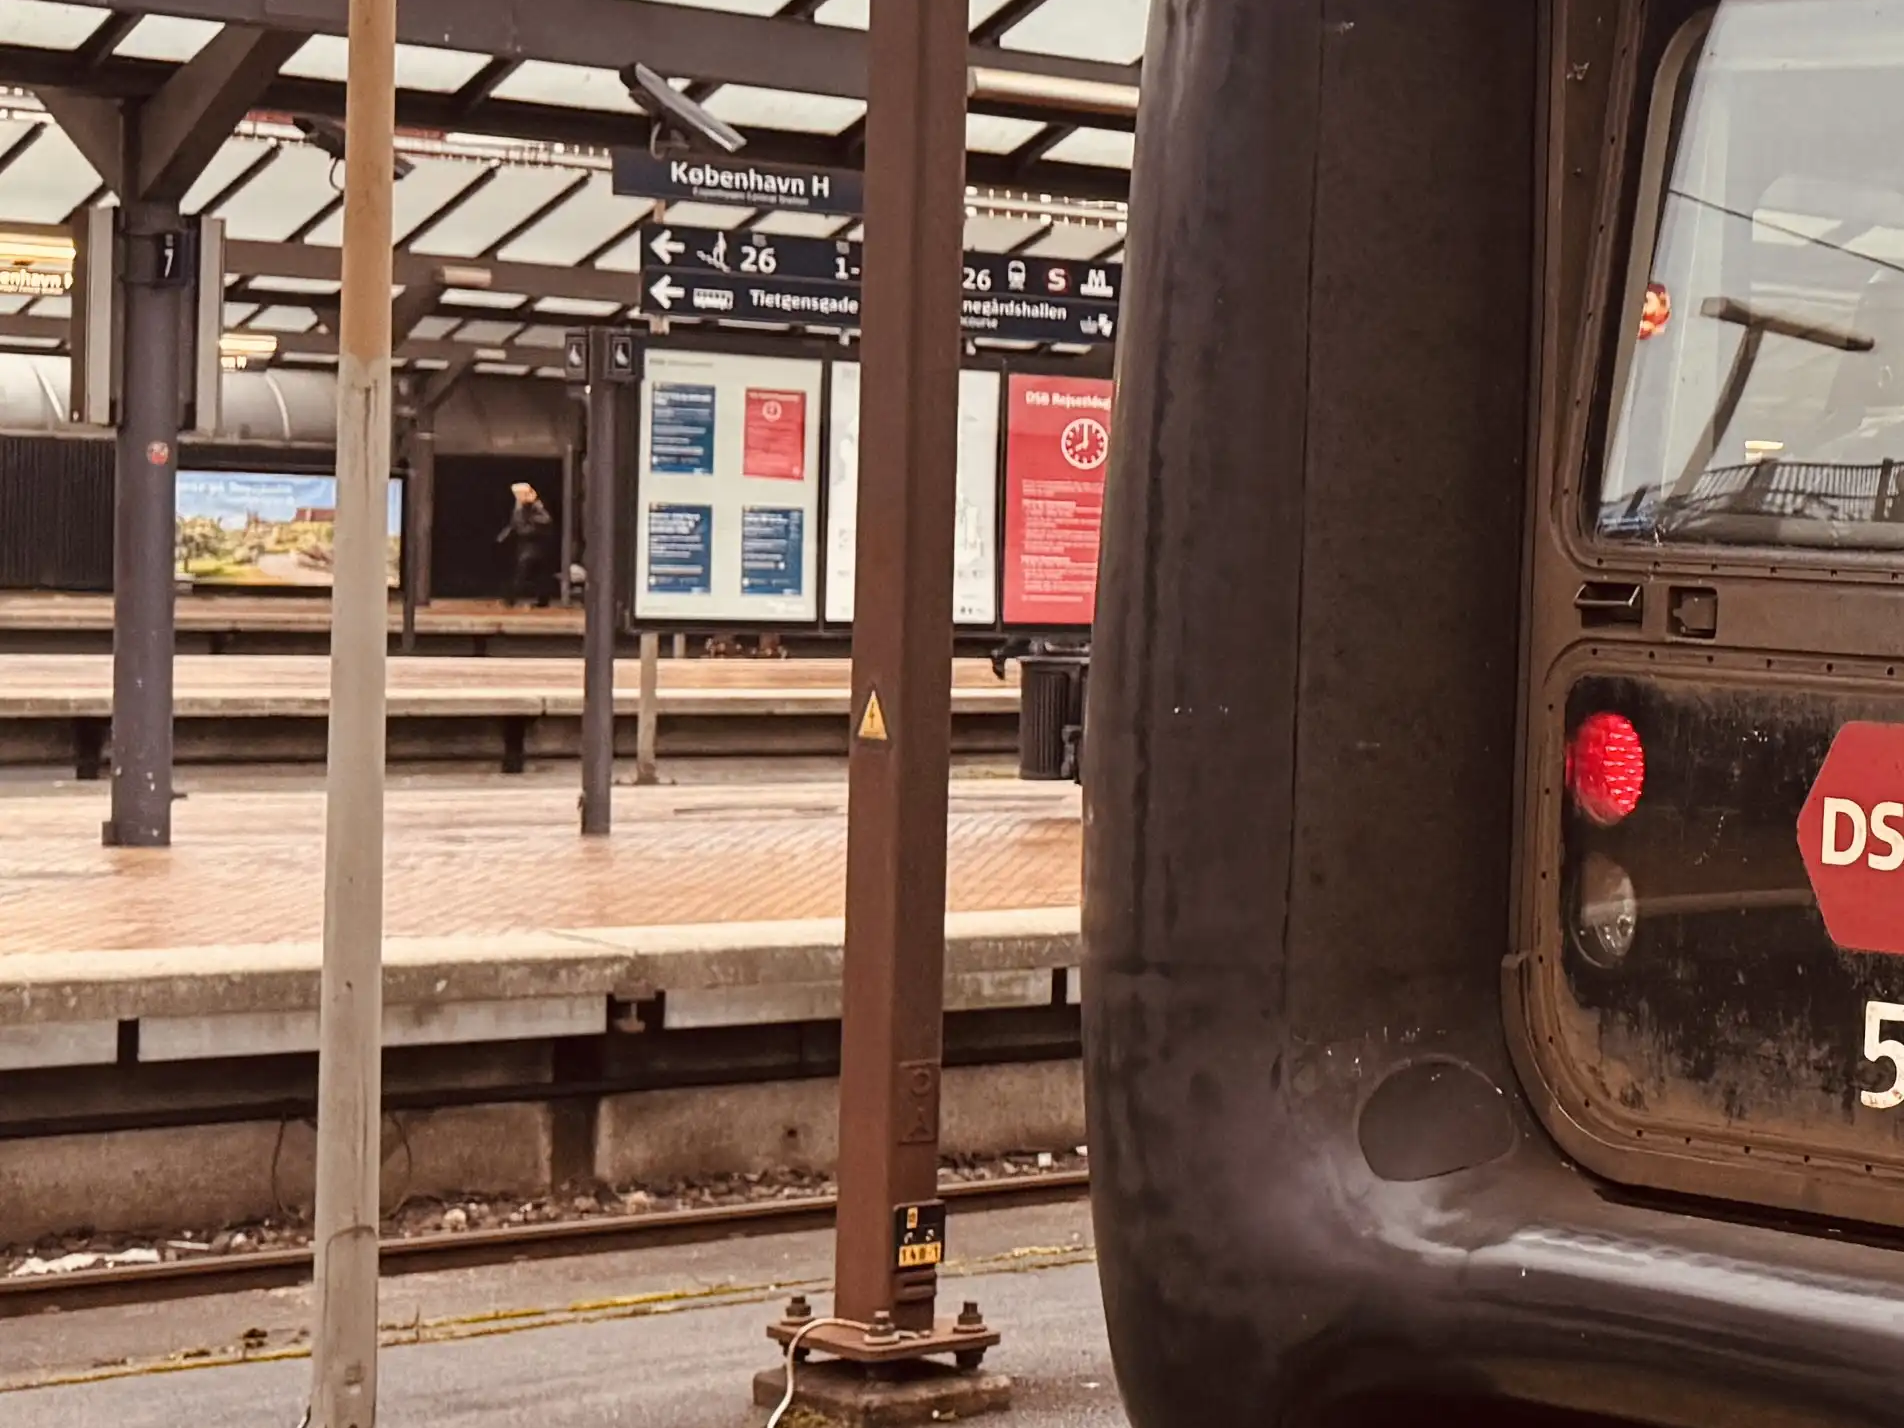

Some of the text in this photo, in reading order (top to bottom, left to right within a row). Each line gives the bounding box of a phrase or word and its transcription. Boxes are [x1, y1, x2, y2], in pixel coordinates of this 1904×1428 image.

[671, 160, 805, 196] København
[812, 175, 830, 198] H
[164, 248, 174, 278] 7
[740, 246, 776, 274] 26
[835, 257, 992, 291] 1- 26
[1048, 268, 1067, 292] S
[750, 288, 859, 315] Tietgensgade
[963, 298, 1067, 321] negårdshallen
